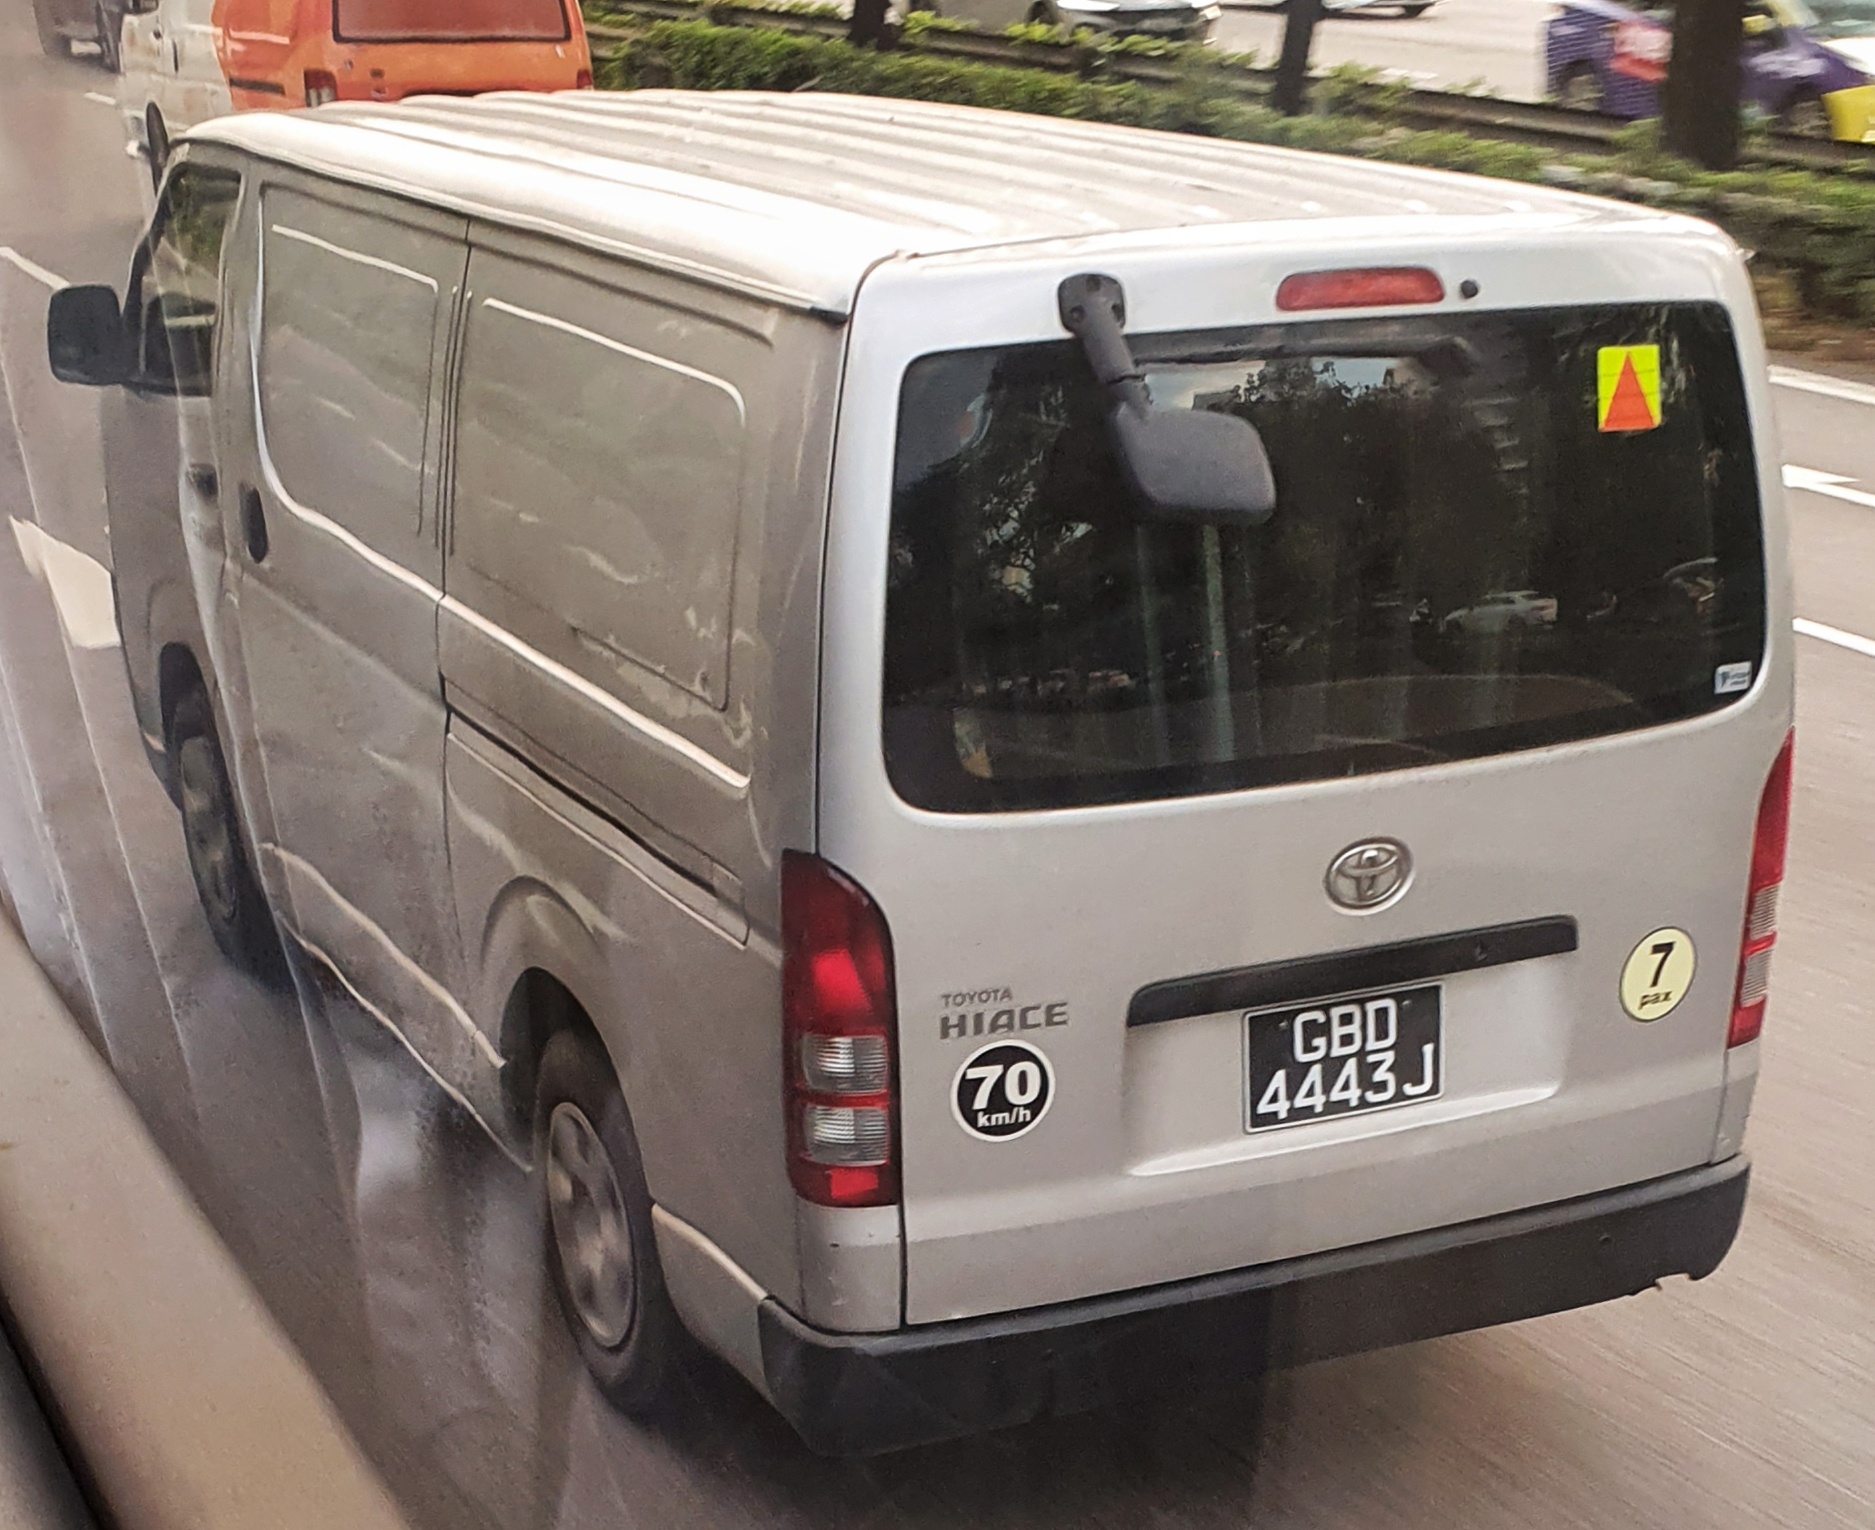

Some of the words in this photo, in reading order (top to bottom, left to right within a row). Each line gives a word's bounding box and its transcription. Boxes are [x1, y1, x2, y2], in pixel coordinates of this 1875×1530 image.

[1650, 941, 1676, 988] 7
[940, 986, 1014, 1007] TOYOTA
[1638, 991, 1672, 1010] pax
[940, 1002, 1069, 1040] HIACE
[1293, 998, 1397, 1063] GBD
[965, 1061, 1041, 1110] 70
[1256, 1042, 1434, 1120] 4443J
[977, 1106, 1031, 1128] km/h
